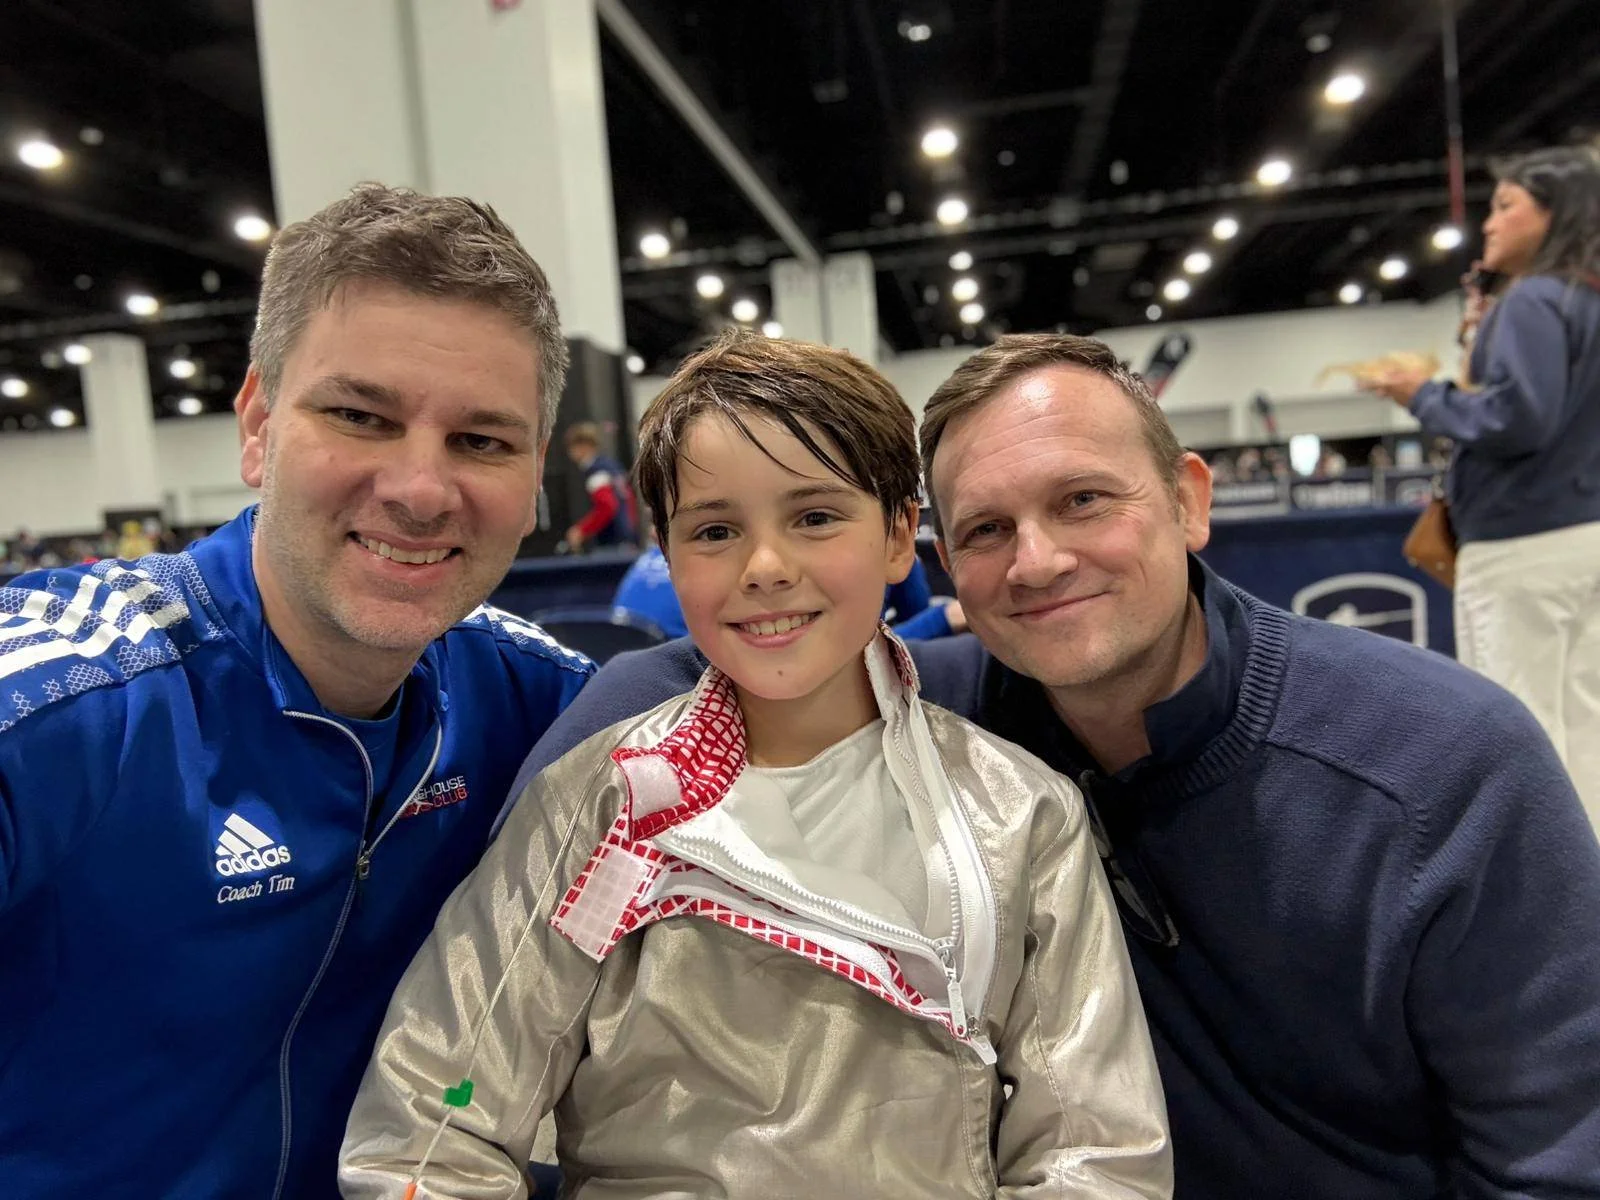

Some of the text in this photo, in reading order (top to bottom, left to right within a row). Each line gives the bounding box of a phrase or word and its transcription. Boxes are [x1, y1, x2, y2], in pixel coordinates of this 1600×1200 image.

[433, 787, 468, 807] CLUB
[216, 845, 291, 876] adidas
[217, 874, 295, 903] Coach Tim
